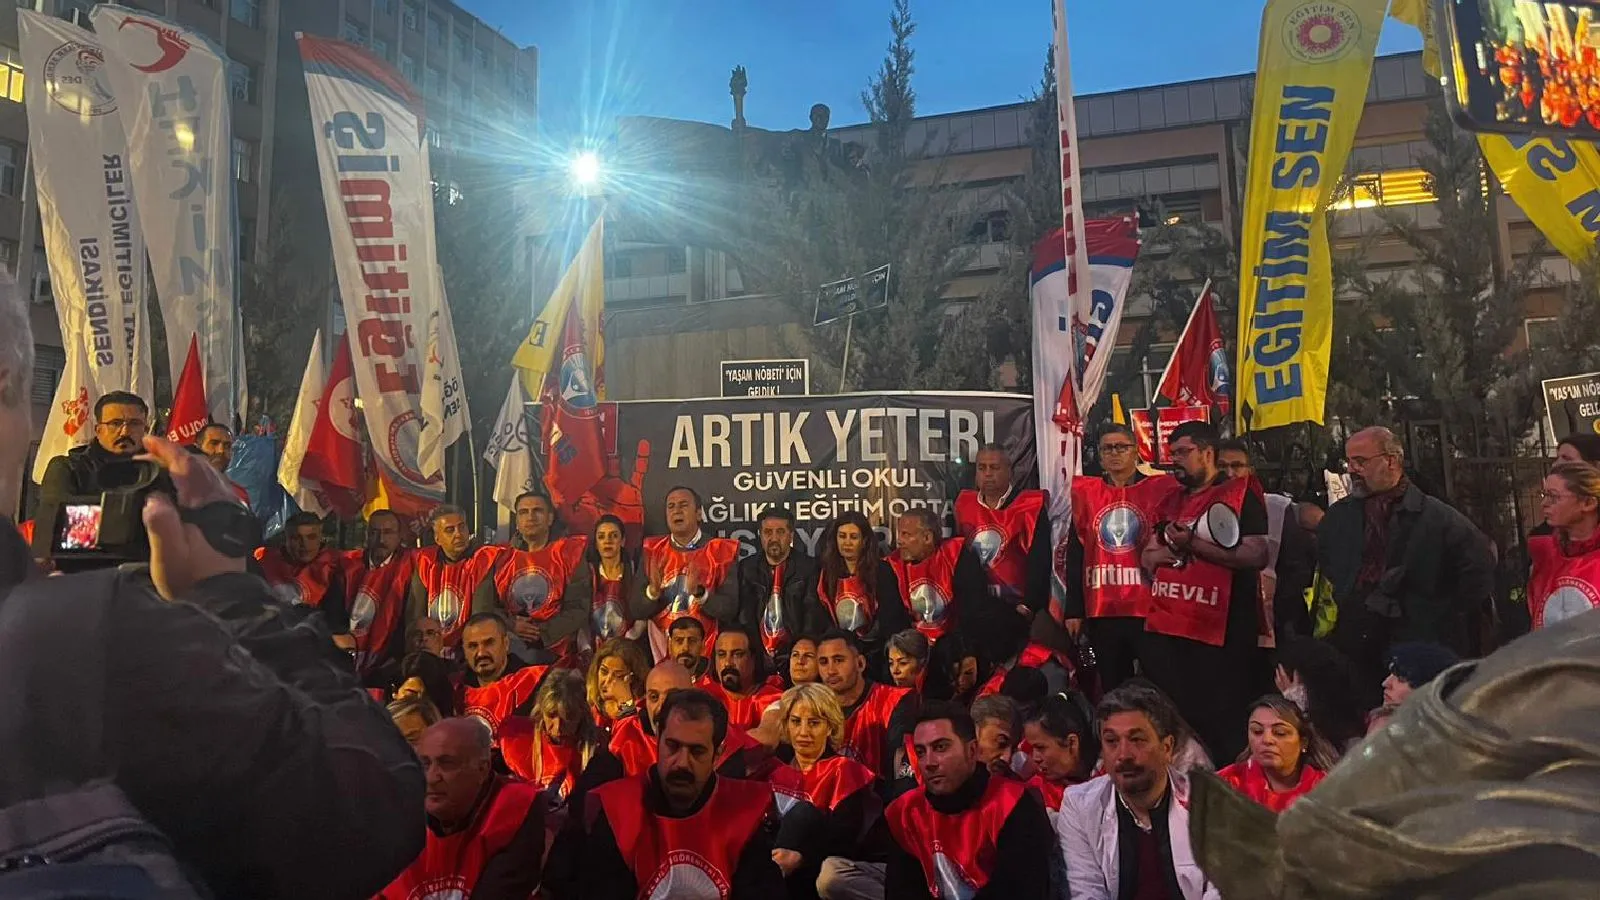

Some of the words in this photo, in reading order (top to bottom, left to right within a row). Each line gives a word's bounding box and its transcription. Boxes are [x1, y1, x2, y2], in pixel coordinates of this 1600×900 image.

[1271, 85, 1336, 190] SEN
[668, 411, 812, 469] ARTIK
[825, 407, 995, 464] YETER!
[733, 469, 847, 491] GÜVENLİ
[851, 468, 933, 491] OKUL,
[1151, 577, 1219, 606] ÖREVLİ
